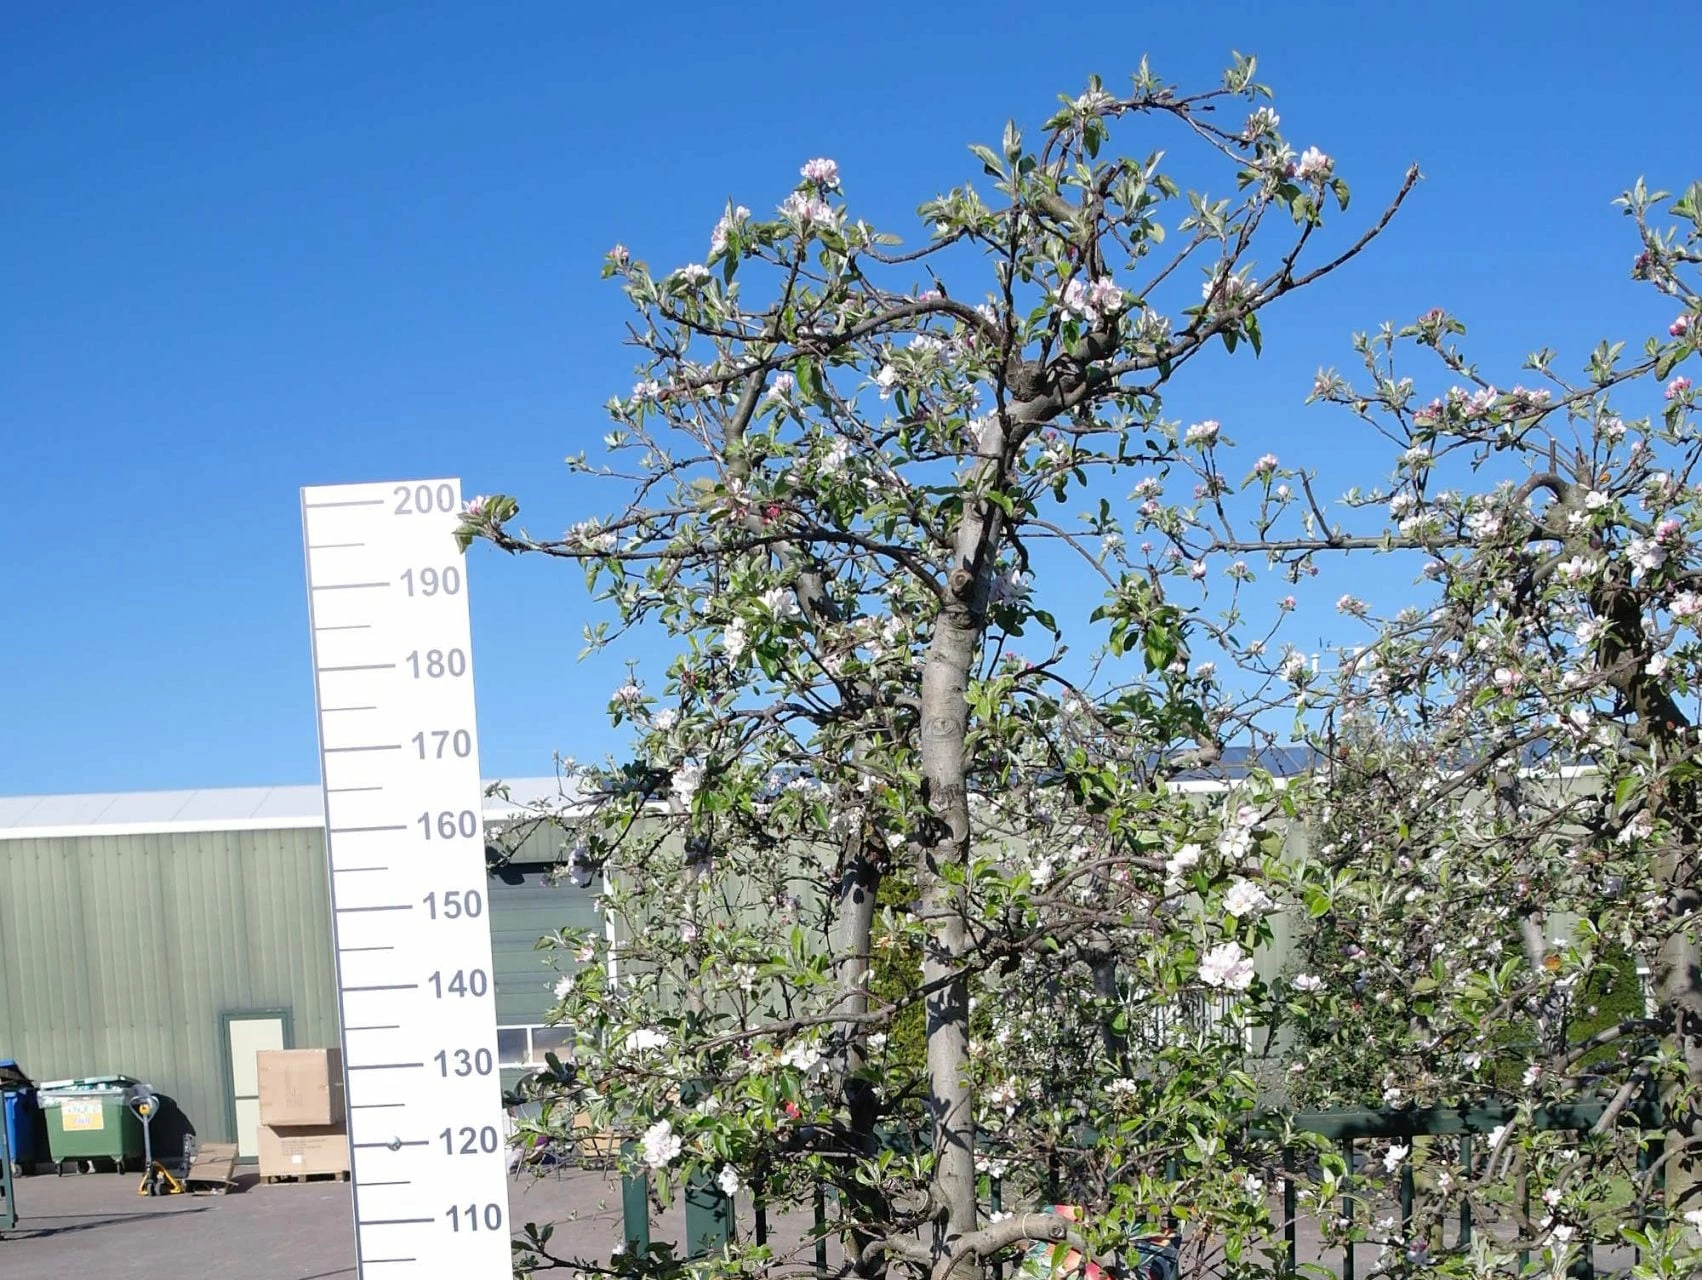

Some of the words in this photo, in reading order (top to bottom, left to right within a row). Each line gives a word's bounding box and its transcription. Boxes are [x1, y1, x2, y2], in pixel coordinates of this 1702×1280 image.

[394, 484, 454, 514] 200
[401, 567, 460, 596] 190
[406, 648, 465, 678] 180
[412, 729, 471, 759] 170
[418, 810, 476, 840] 160
[423, 890, 481, 919] 150
[429, 969, 487, 998] 140
[434, 1048, 492, 1077] 130
[440, 1126, 497, 1155] 120
[446, 1203, 501, 1232] 110
